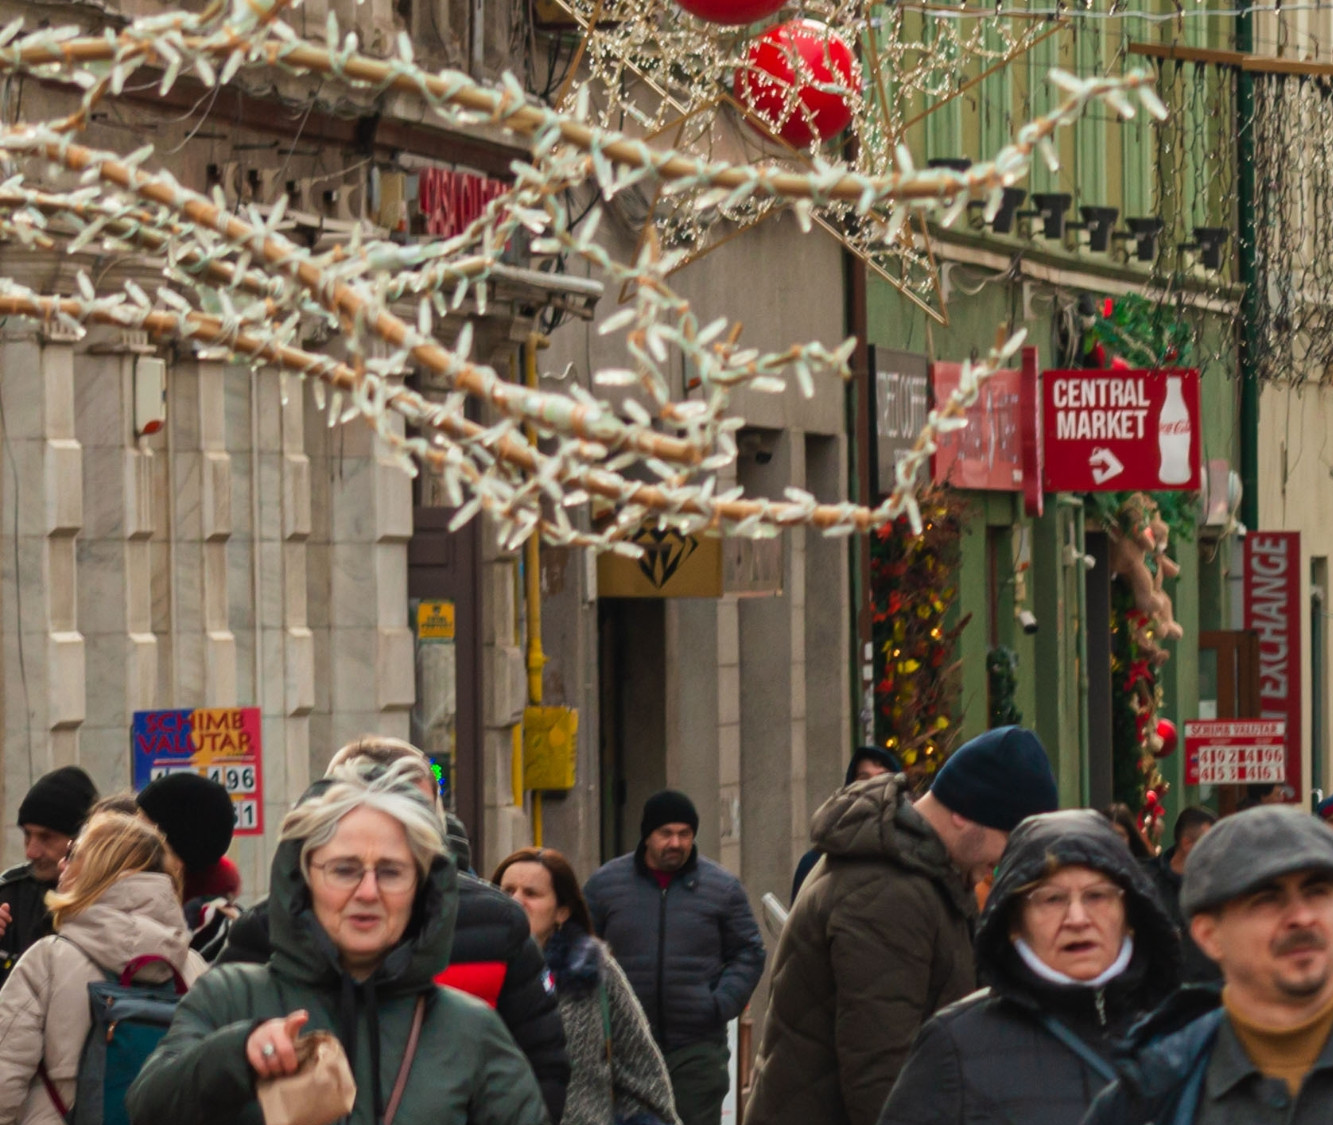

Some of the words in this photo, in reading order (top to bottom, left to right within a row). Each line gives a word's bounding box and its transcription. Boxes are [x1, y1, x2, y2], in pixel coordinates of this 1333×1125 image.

[1053, 378, 1151, 408] CENTRAL
[1057, 409, 1148, 440] MARKET
[1251, 537, 1288, 698] EXCHANGE
[146, 712, 244, 733] SCHIMB
[138, 732, 254, 754] VALUTAR
